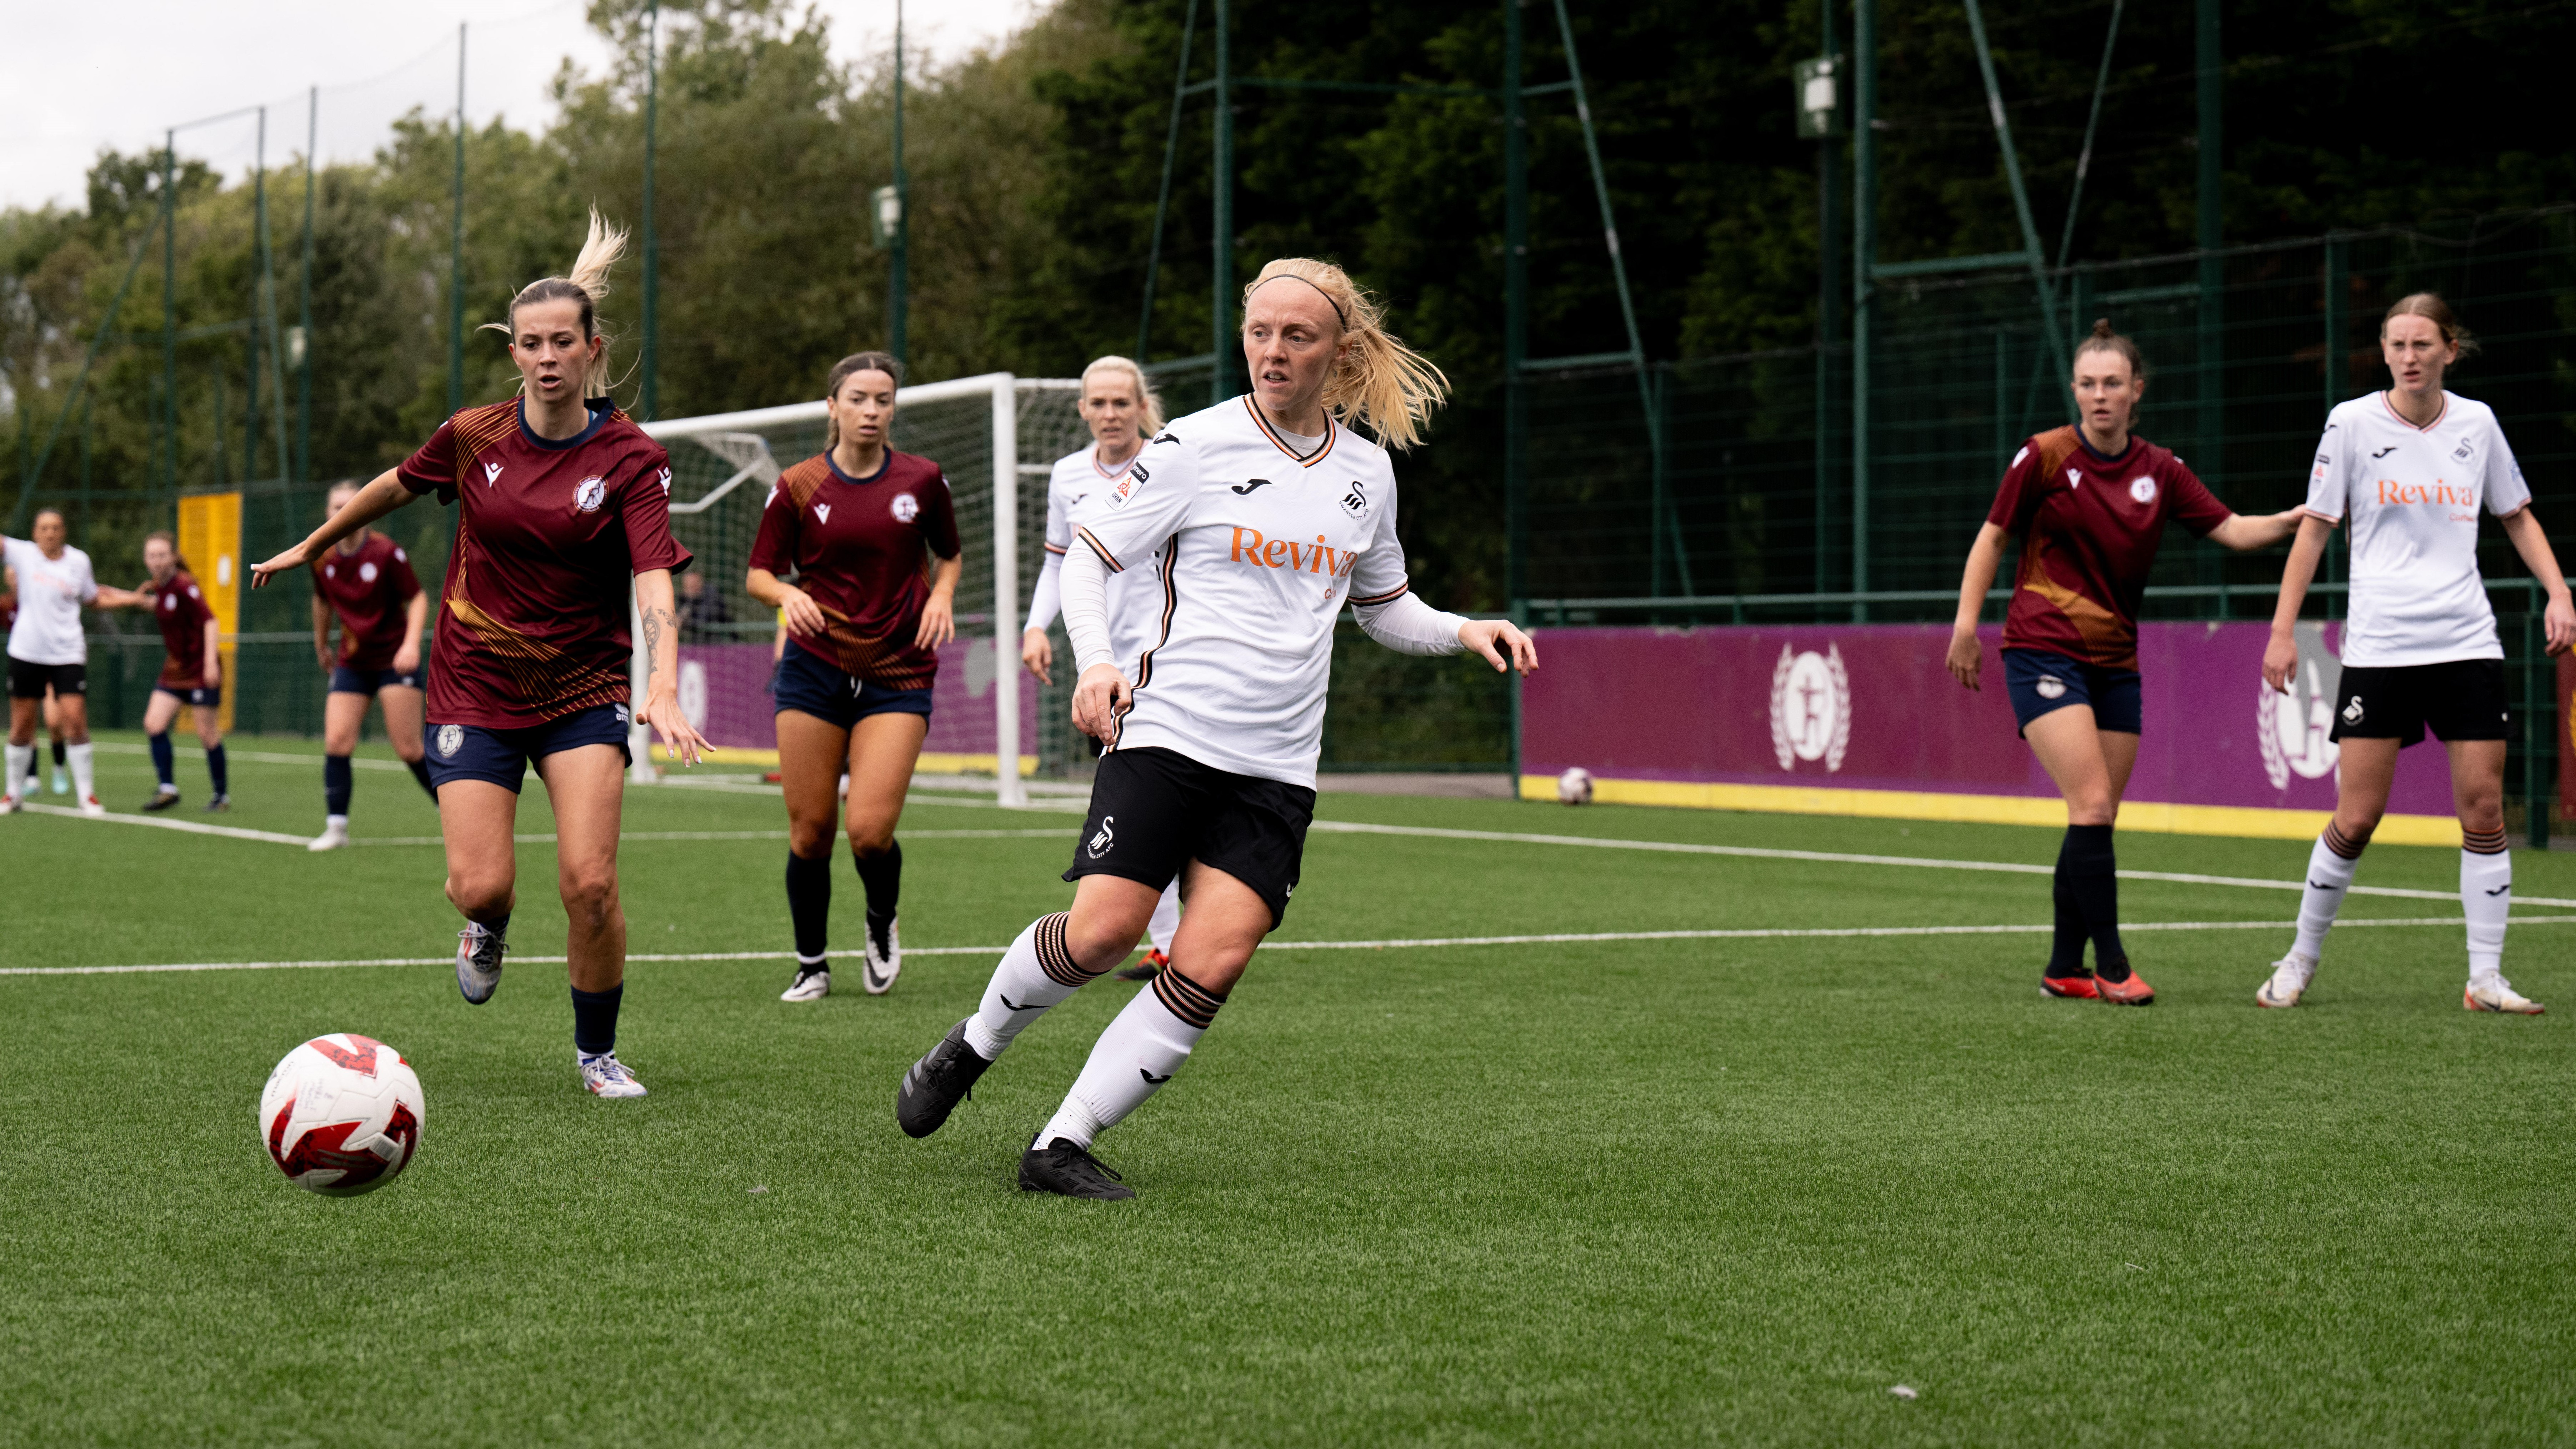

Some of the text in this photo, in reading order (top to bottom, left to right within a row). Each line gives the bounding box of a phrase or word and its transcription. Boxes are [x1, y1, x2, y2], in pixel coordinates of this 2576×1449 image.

[2378, 478, 2472, 507] Reviva
[1339, 501, 1355, 519] SWANSEA
[1230, 527, 1358, 578] Reviva
